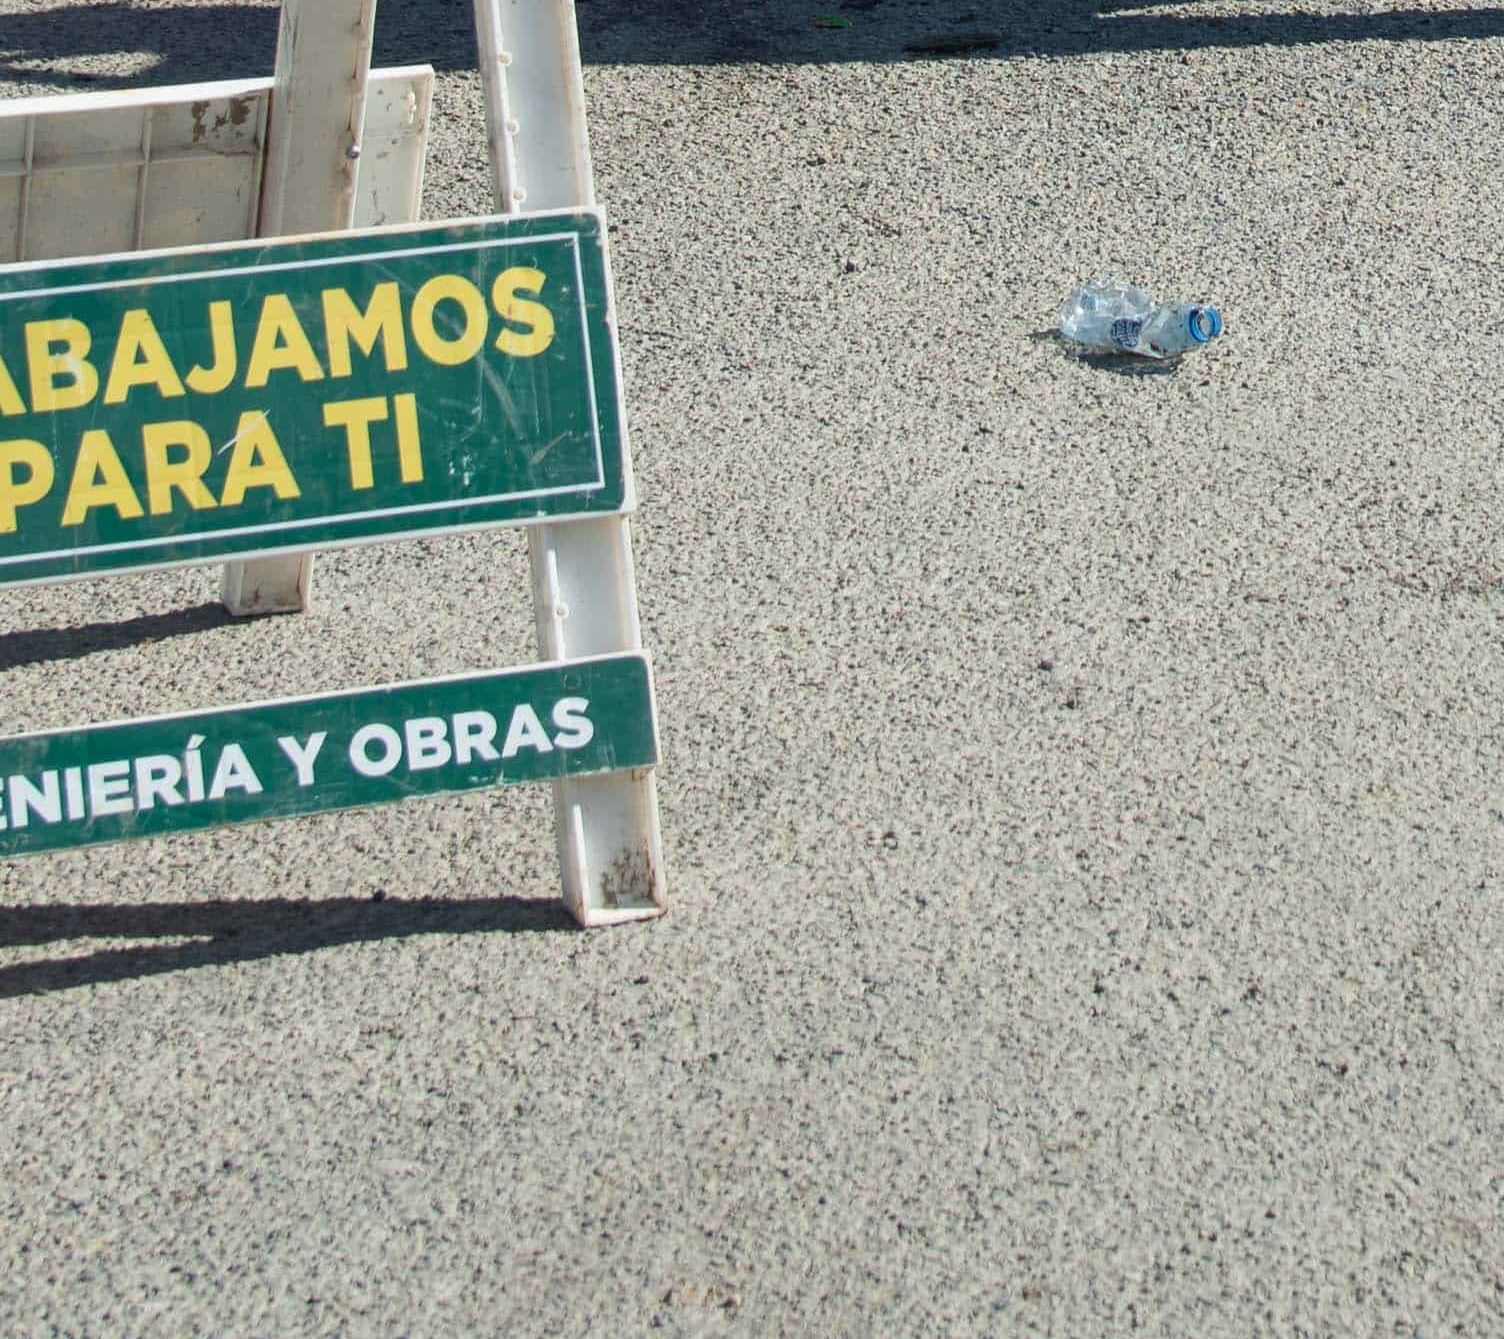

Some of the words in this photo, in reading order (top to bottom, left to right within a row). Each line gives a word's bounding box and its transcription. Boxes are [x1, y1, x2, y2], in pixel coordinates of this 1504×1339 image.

[322, 392, 424, 491] TI
[278, 734, 327, 788] Y
[348, 696, 595, 779] OBRAS
